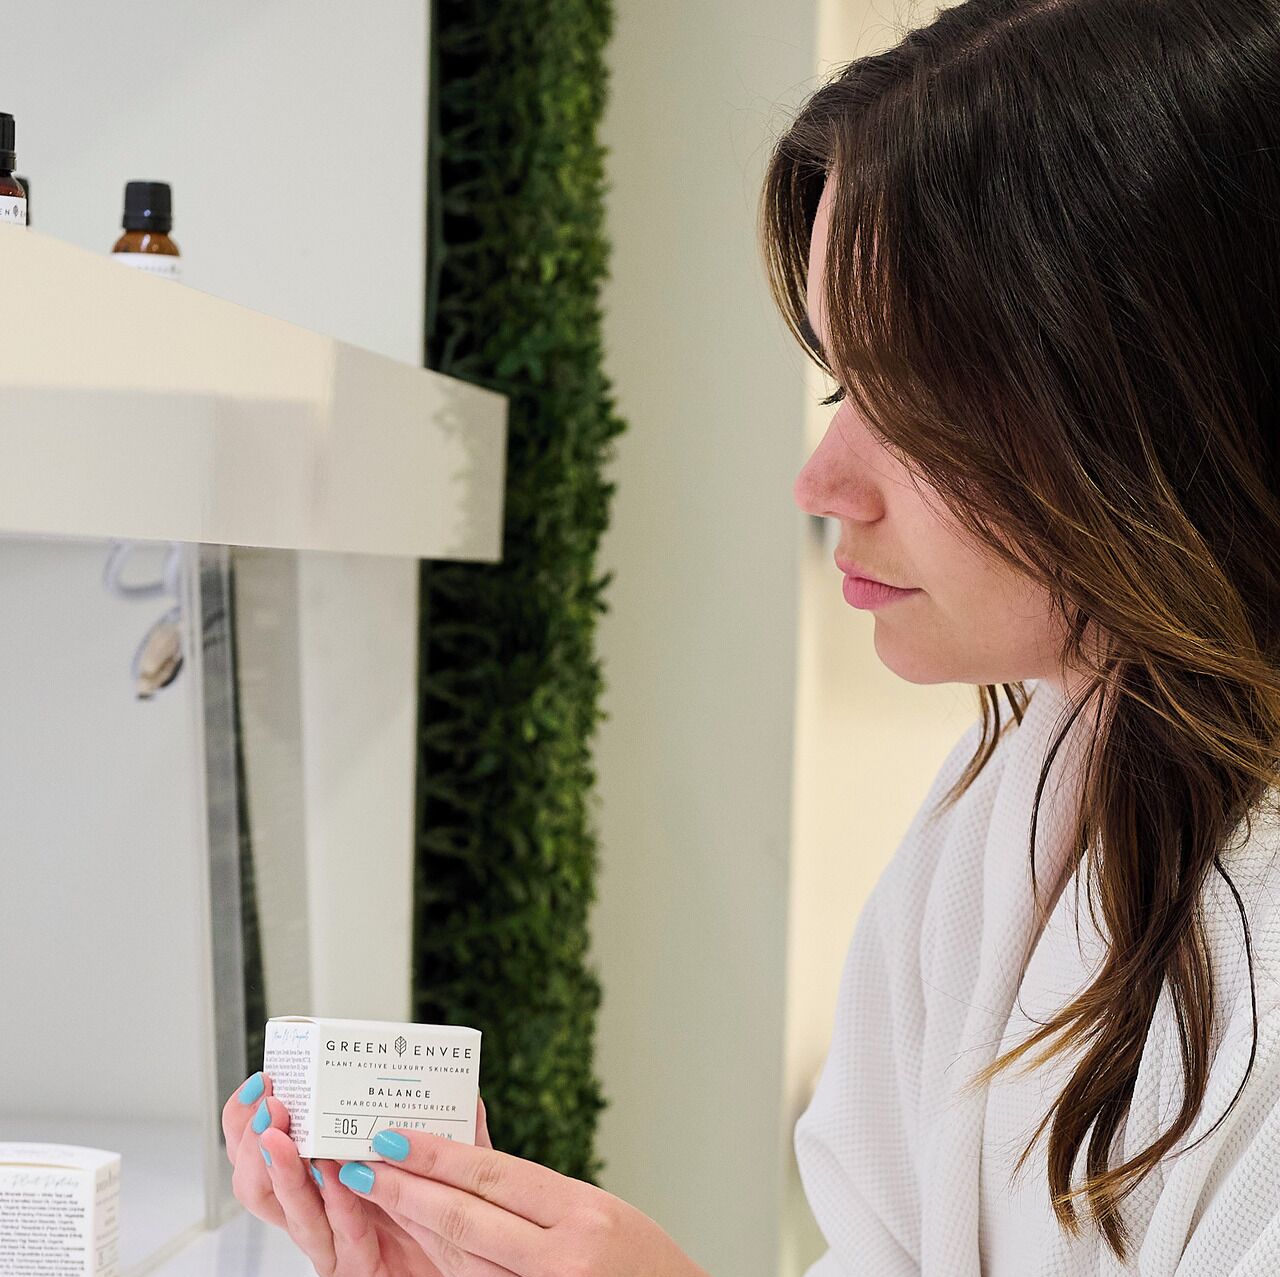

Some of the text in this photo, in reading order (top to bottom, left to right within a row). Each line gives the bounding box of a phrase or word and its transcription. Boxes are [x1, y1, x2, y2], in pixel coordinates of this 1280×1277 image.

[326, 1040, 472, 1059] GREEN ENVEE
[357, 1062, 388, 1070] ACTIVE
[429, 1066, 471, 1074] SKINCARE
[368, 1087, 431, 1098] BALANCE
[340, 1100, 457, 1112] CHARCOAL MOISTURIZER
[342, 1118, 358, 1135] 05
[388, 1120, 427, 1129] PURIFY
